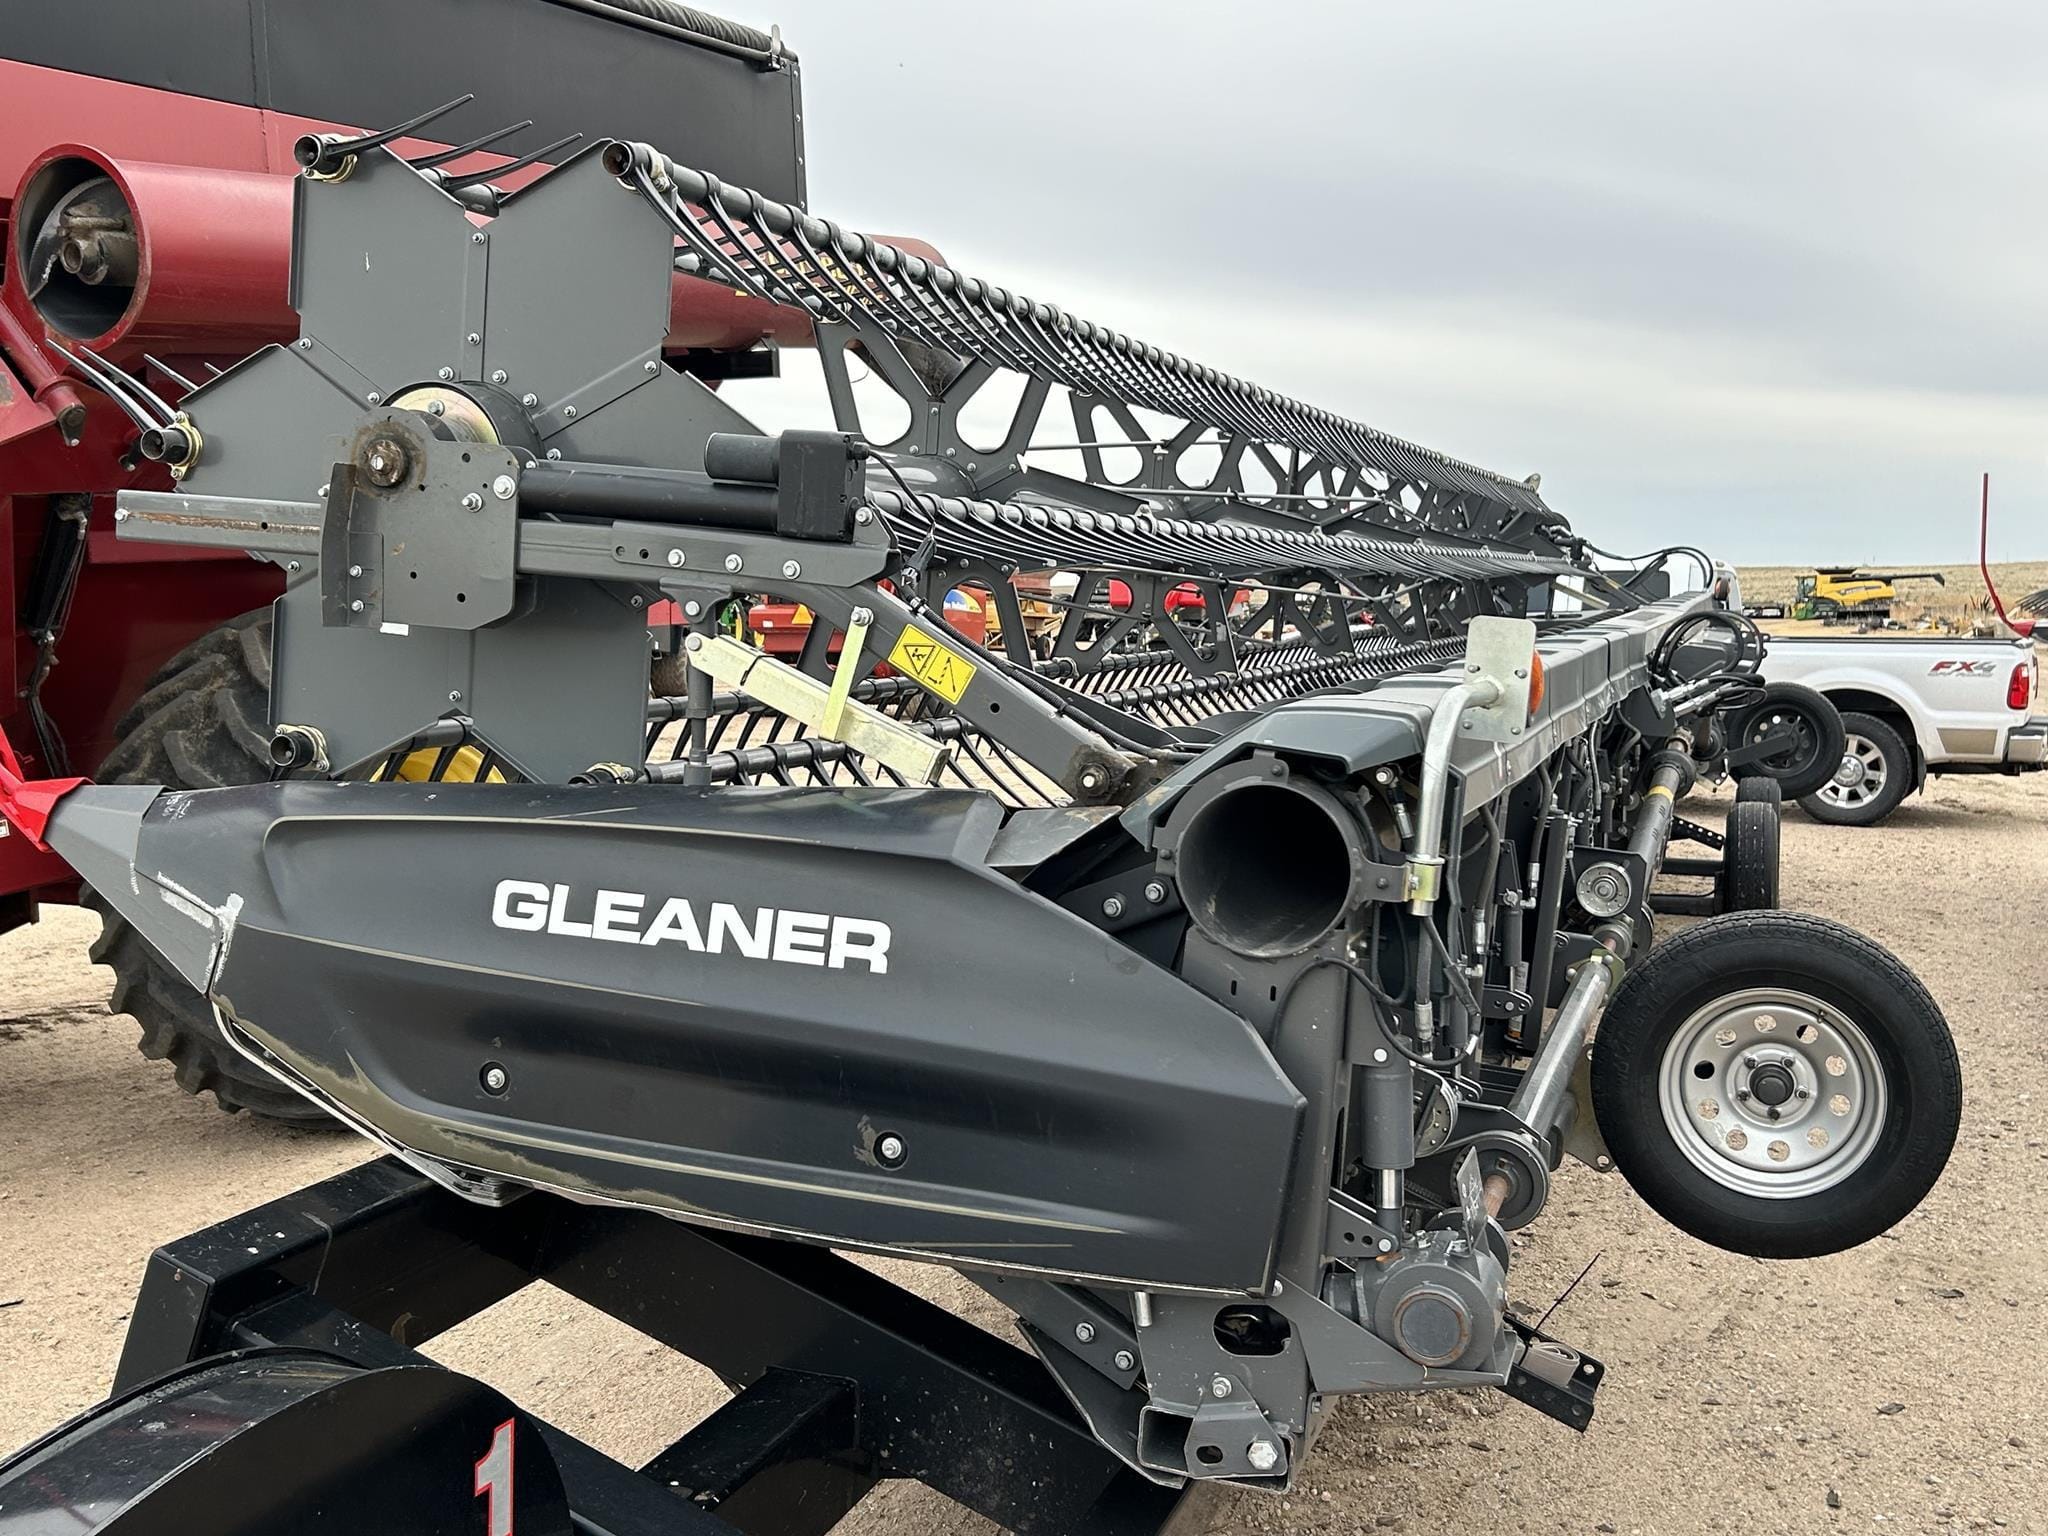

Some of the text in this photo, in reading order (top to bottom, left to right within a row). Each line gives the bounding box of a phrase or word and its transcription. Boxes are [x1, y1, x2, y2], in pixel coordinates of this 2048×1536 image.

[1931, 660, 1997, 673] FX4
[491, 878, 892, 975] GLEANER
[474, 1417, 515, 1536] 1
